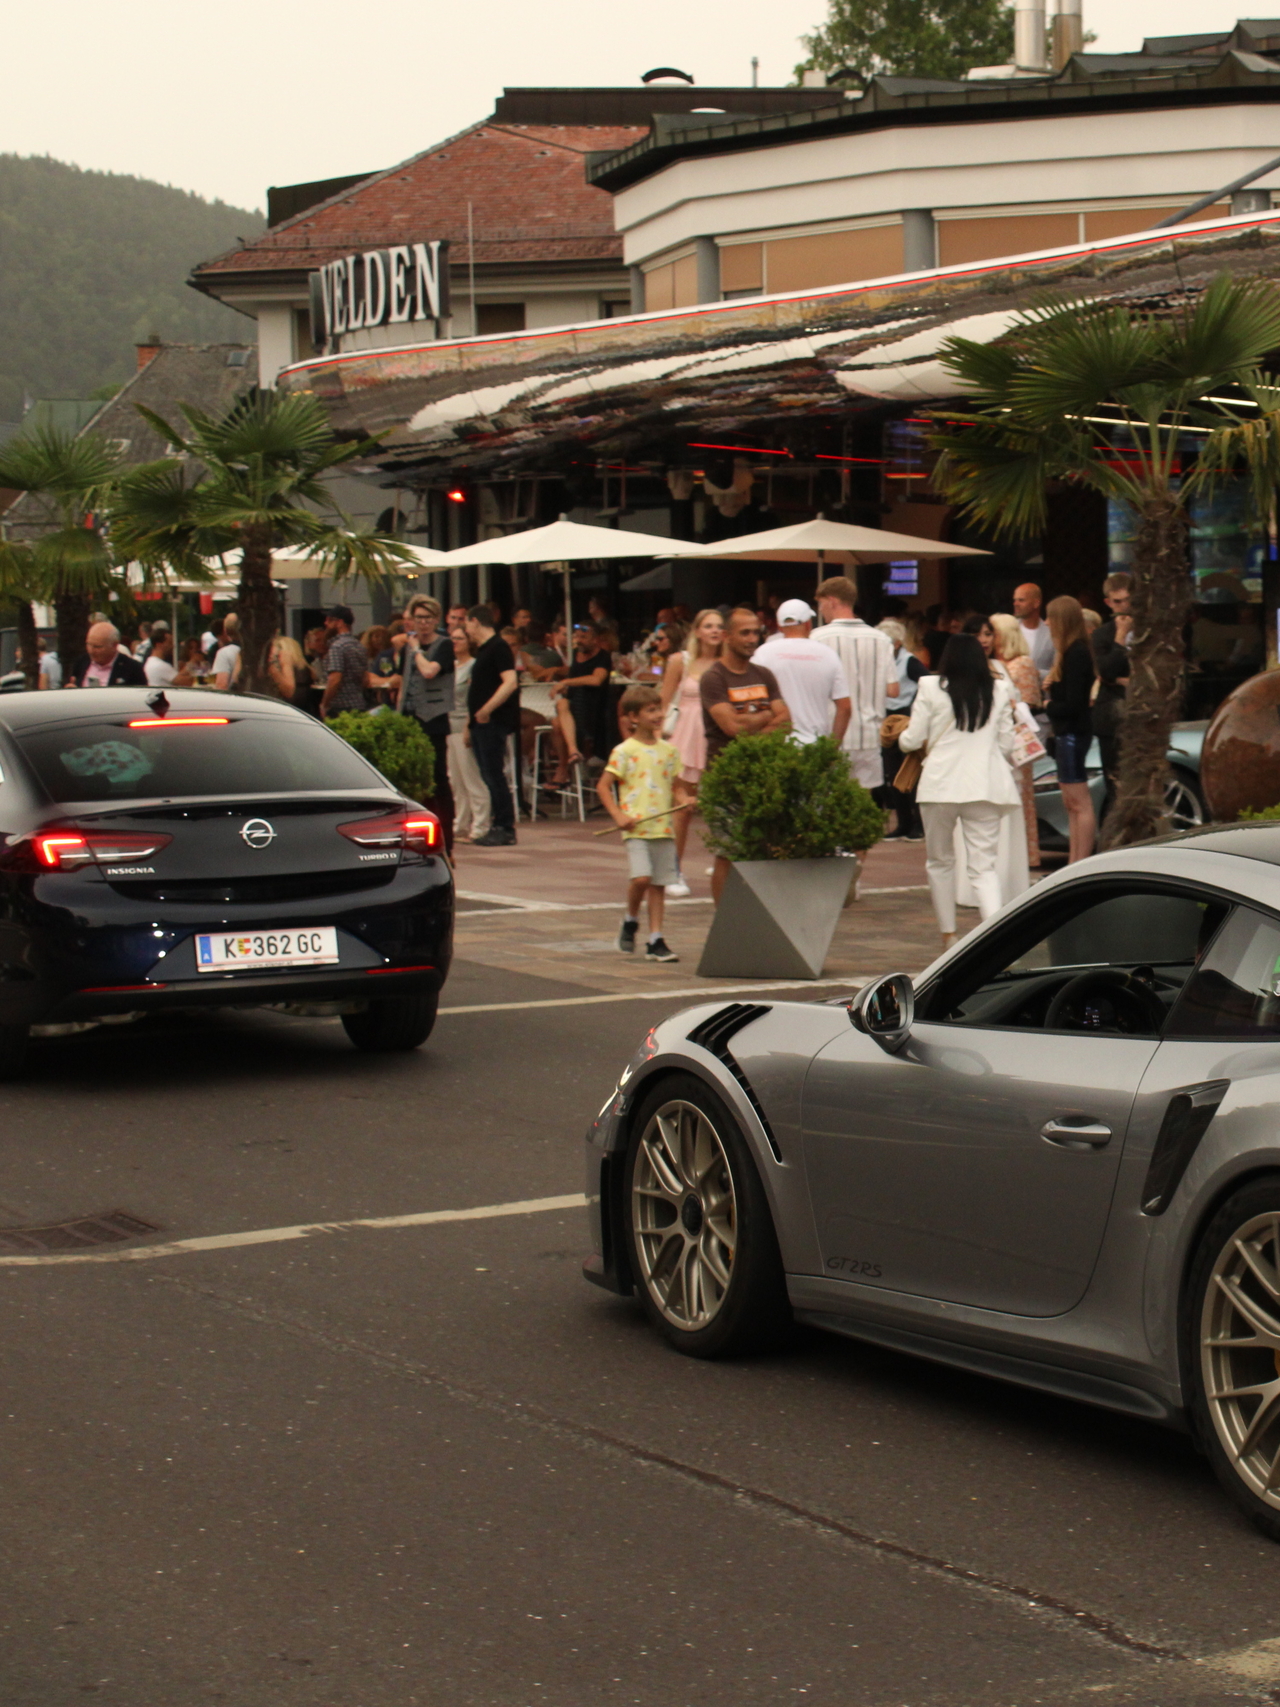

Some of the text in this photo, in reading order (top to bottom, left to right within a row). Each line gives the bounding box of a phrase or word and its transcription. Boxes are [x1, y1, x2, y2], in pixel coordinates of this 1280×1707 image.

[320, 240, 441, 337] VELDEN
[358, 853, 389, 861] TURBO
[107, 867, 156, 875] INSIGNIA
[224, 933, 322, 958] K 362 GC
